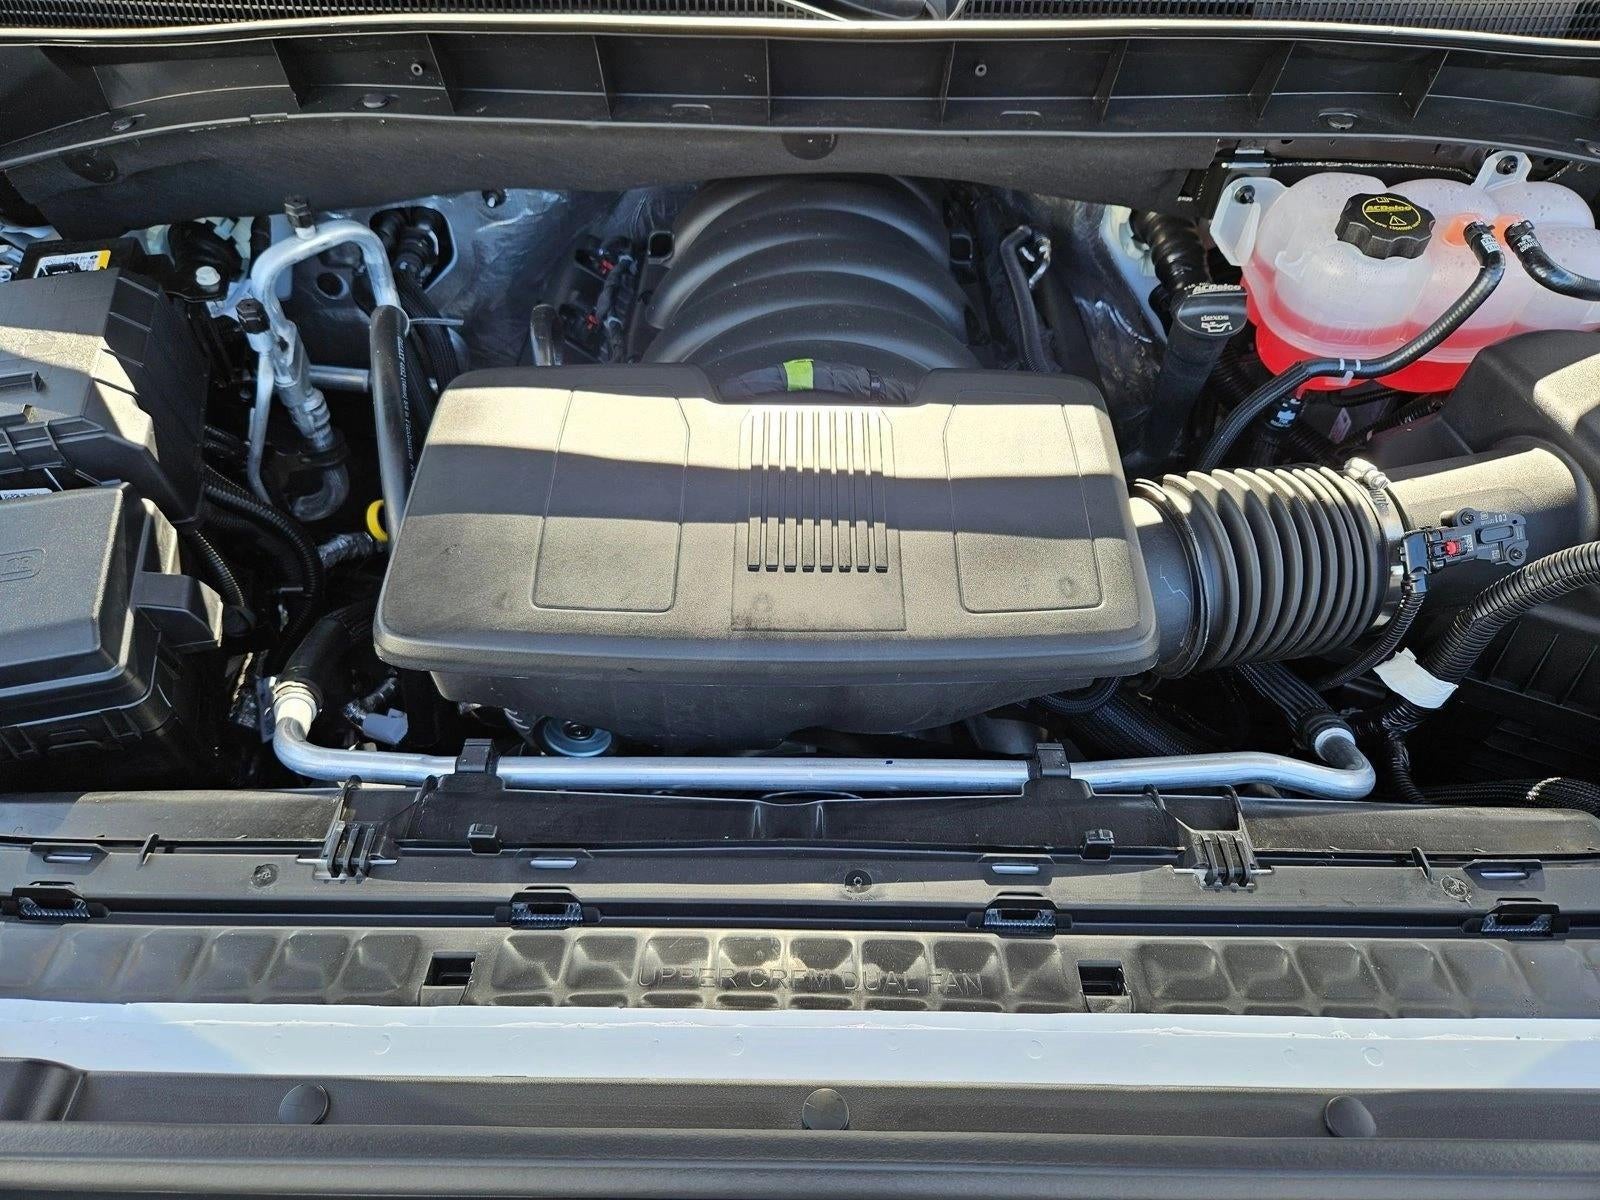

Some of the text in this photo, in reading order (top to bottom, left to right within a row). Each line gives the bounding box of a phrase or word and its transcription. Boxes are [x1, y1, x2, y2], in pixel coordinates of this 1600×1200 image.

[1365, 205, 1412, 213] ACDelco
[1192, 283, 1241, 295] ACDelco
[637, 967, 984, 996] UPPER CRFM DUAL FAN
